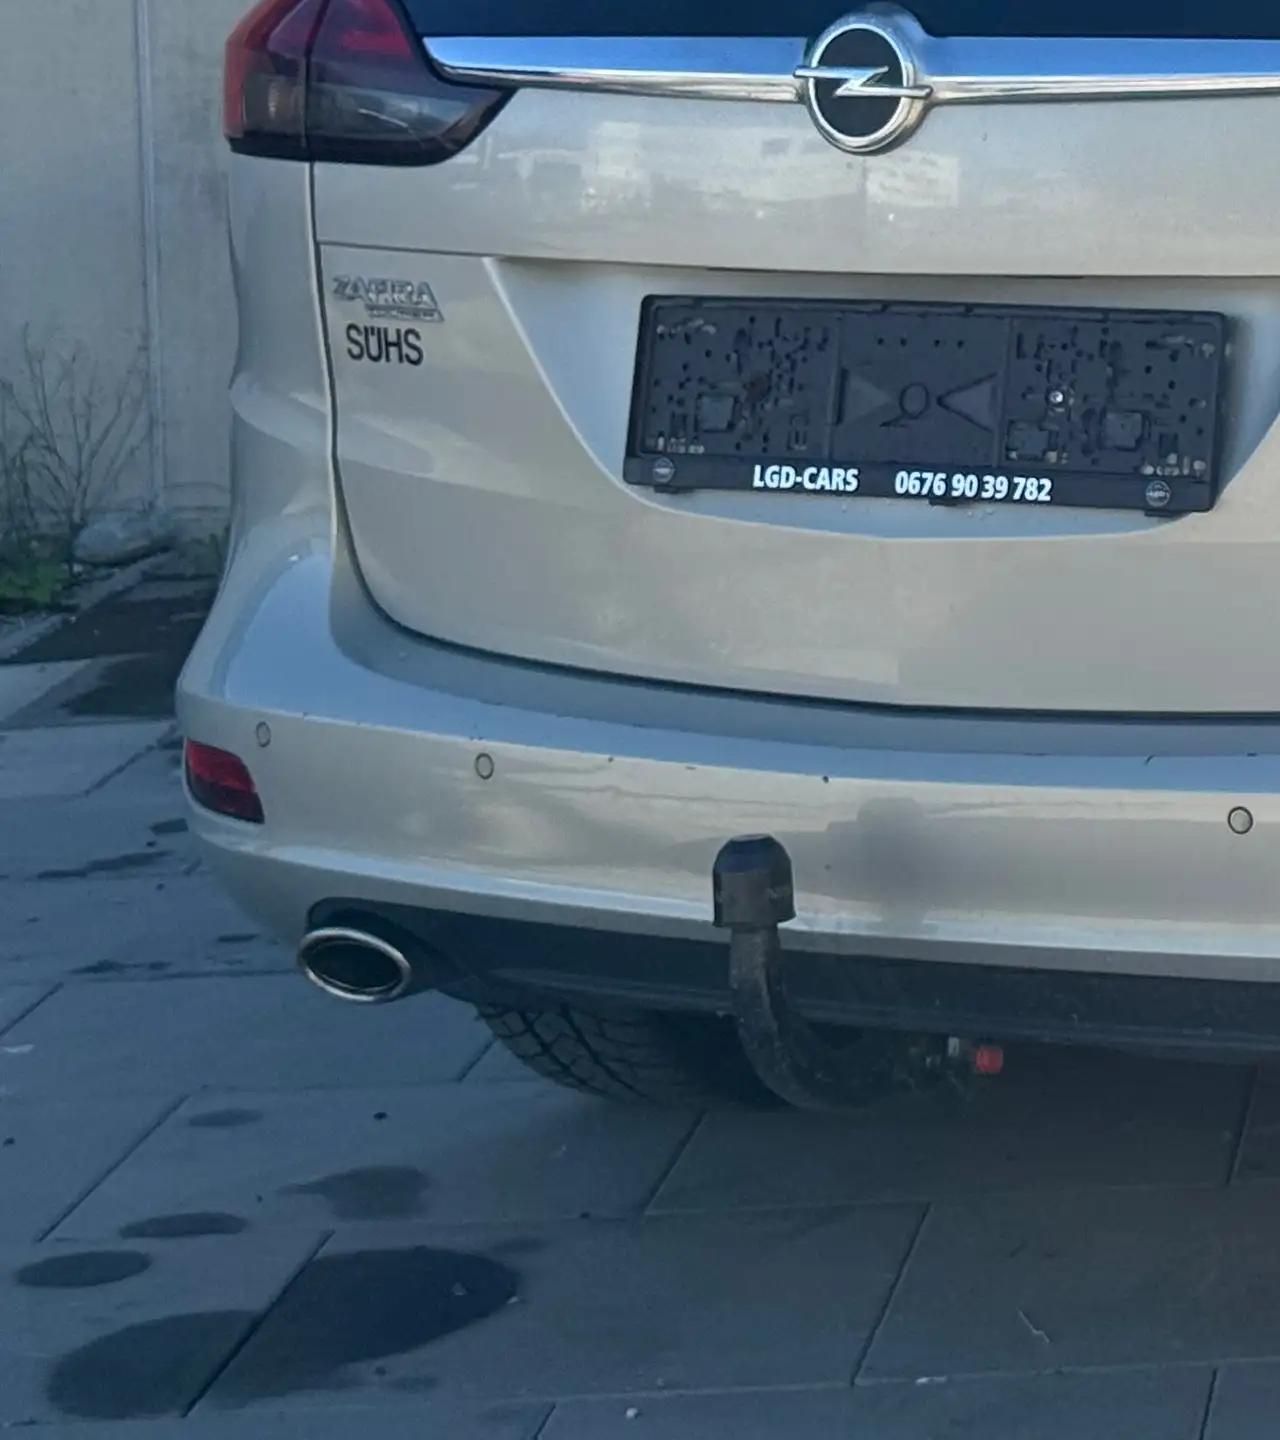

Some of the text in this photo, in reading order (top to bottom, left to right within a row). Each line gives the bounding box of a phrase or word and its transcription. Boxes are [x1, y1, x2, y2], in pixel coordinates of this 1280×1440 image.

[752, 464, 1052, 502] LGD-CARS 0676 90 39 782
